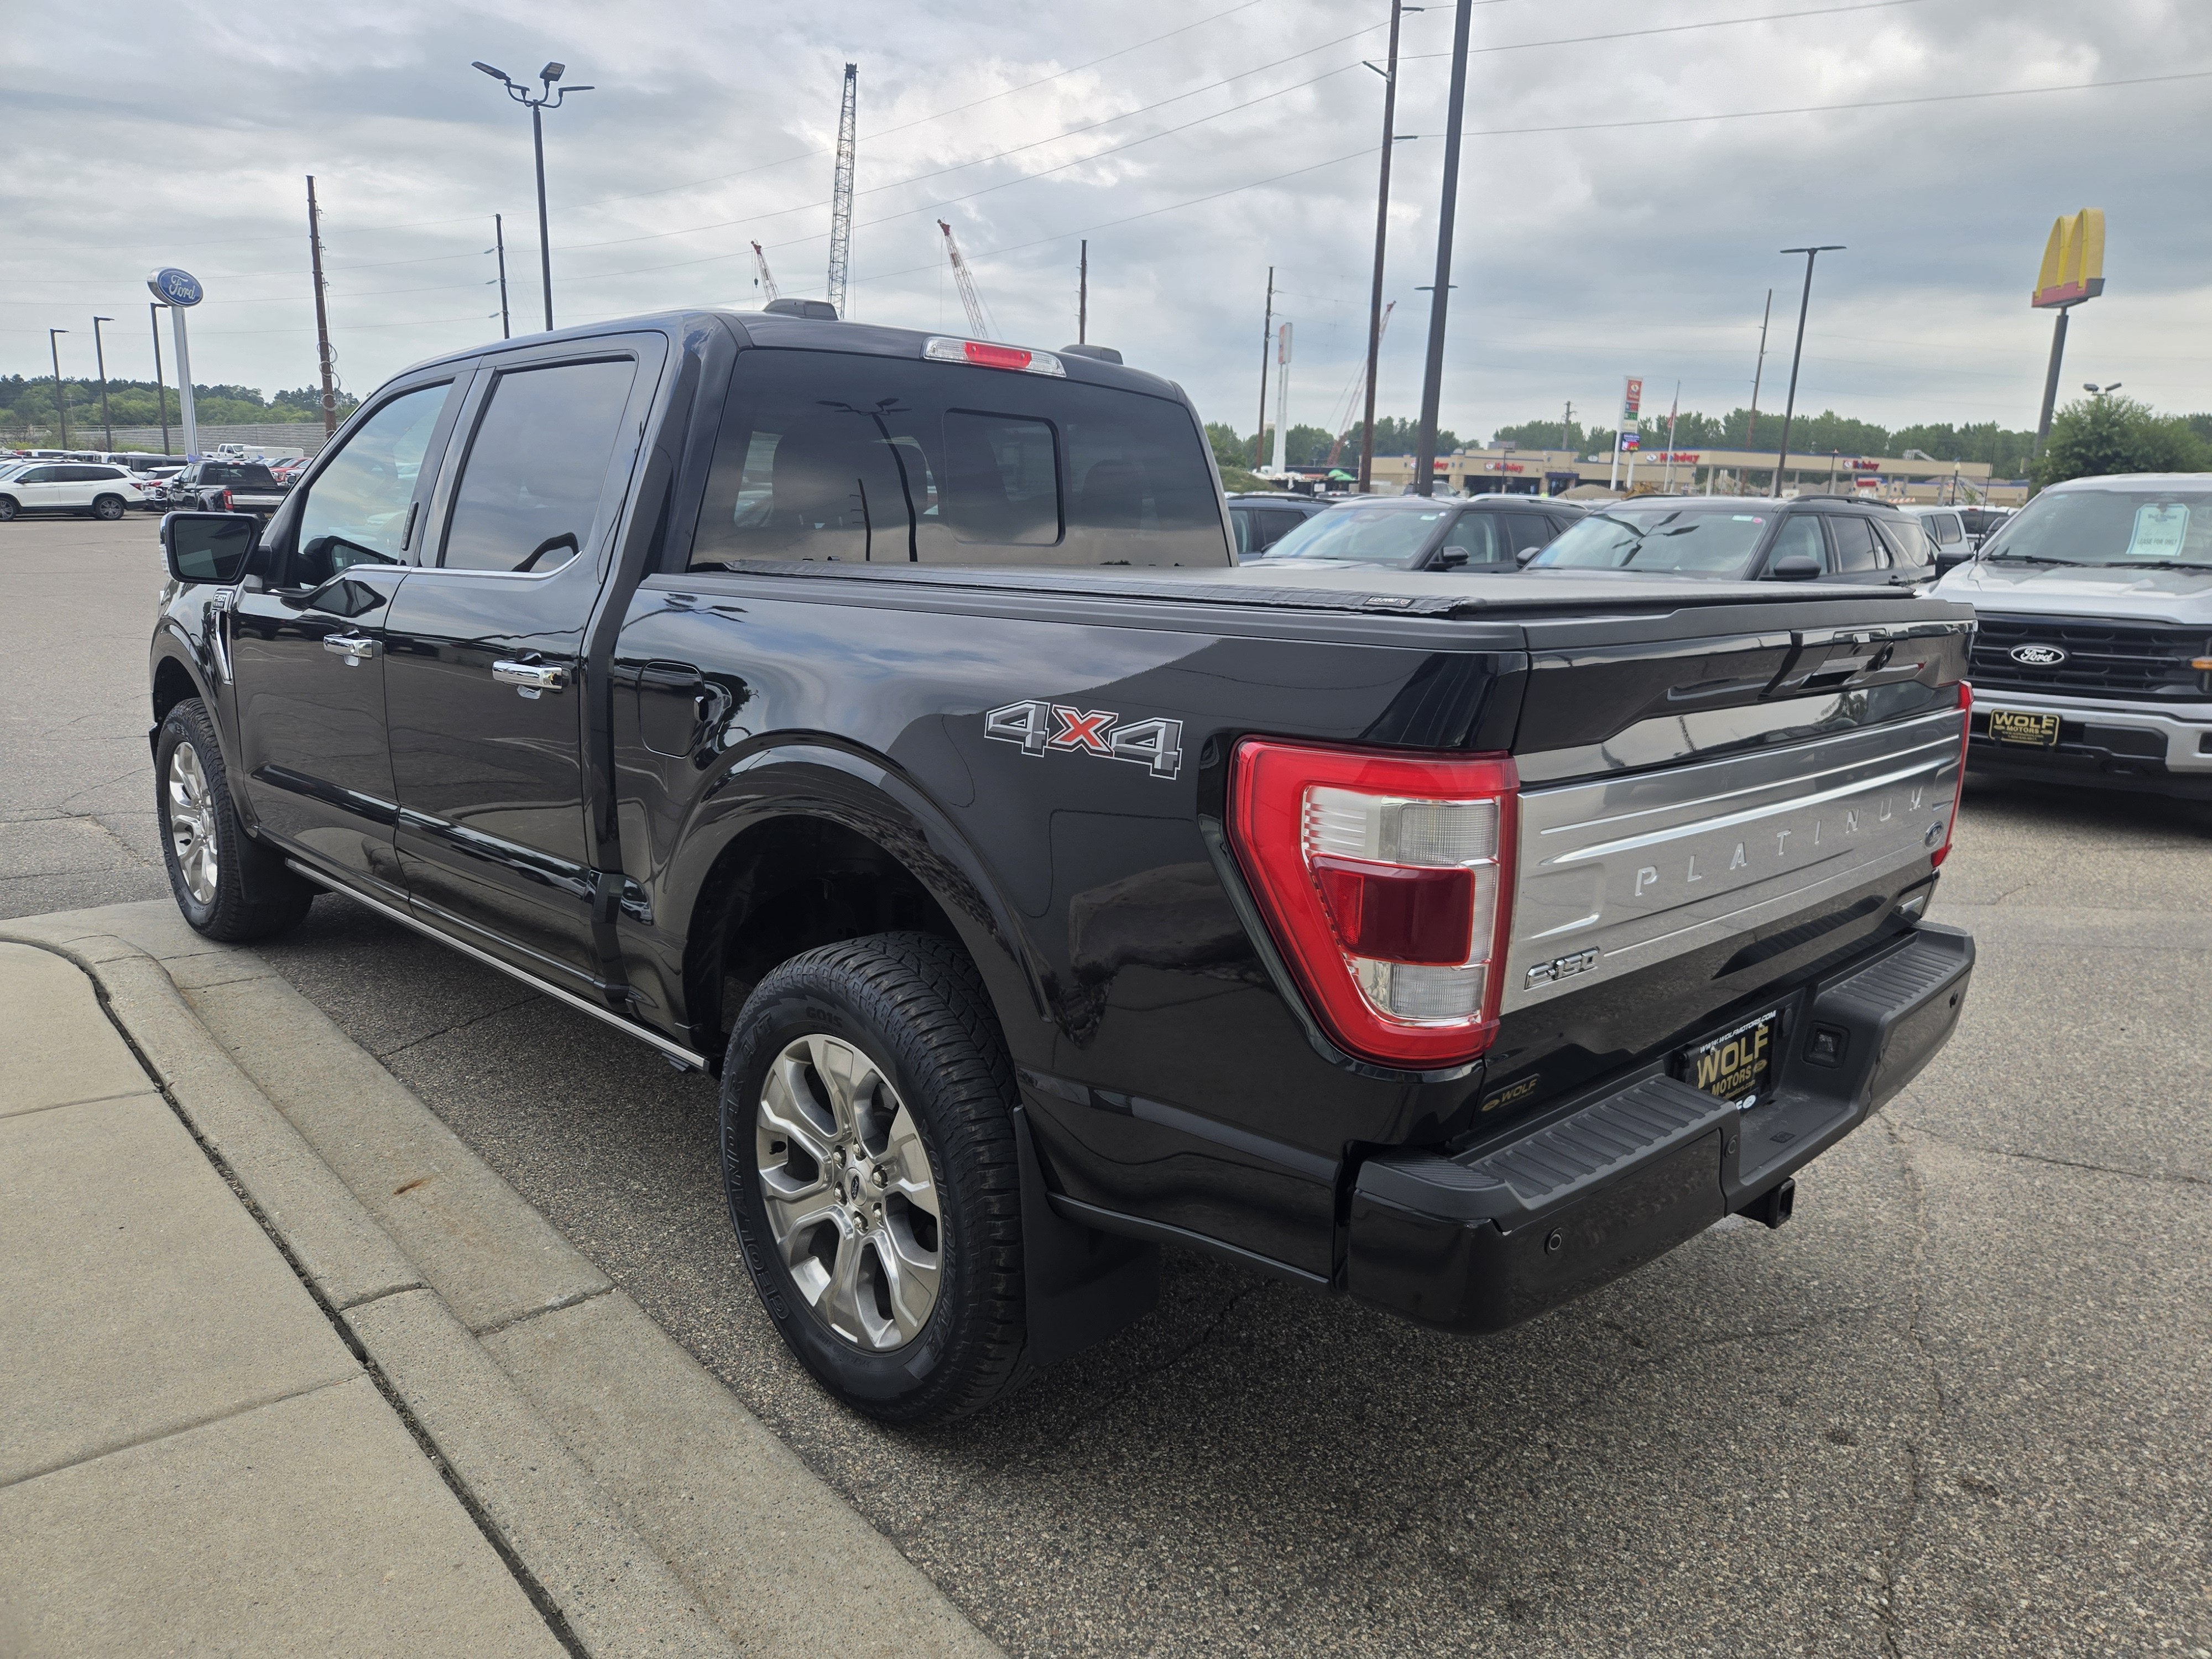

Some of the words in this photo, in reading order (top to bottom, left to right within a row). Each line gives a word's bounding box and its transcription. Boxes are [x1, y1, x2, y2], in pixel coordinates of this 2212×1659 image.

[168, 274, 196, 300] Ford
[2020, 648, 2054, 662] Ford
[1995, 713, 2055, 729] WOLF
[2006, 726, 2039, 734] MOTORS
[1635, 786, 1923, 896] PLATINUM
[1524, 946, 1600, 992] F-150
[1697, 1026, 1768, 1089] WOLF
[1501, 1079, 1537, 1102] WOLF
[1712, 1065, 1752, 1097] MOTORS
